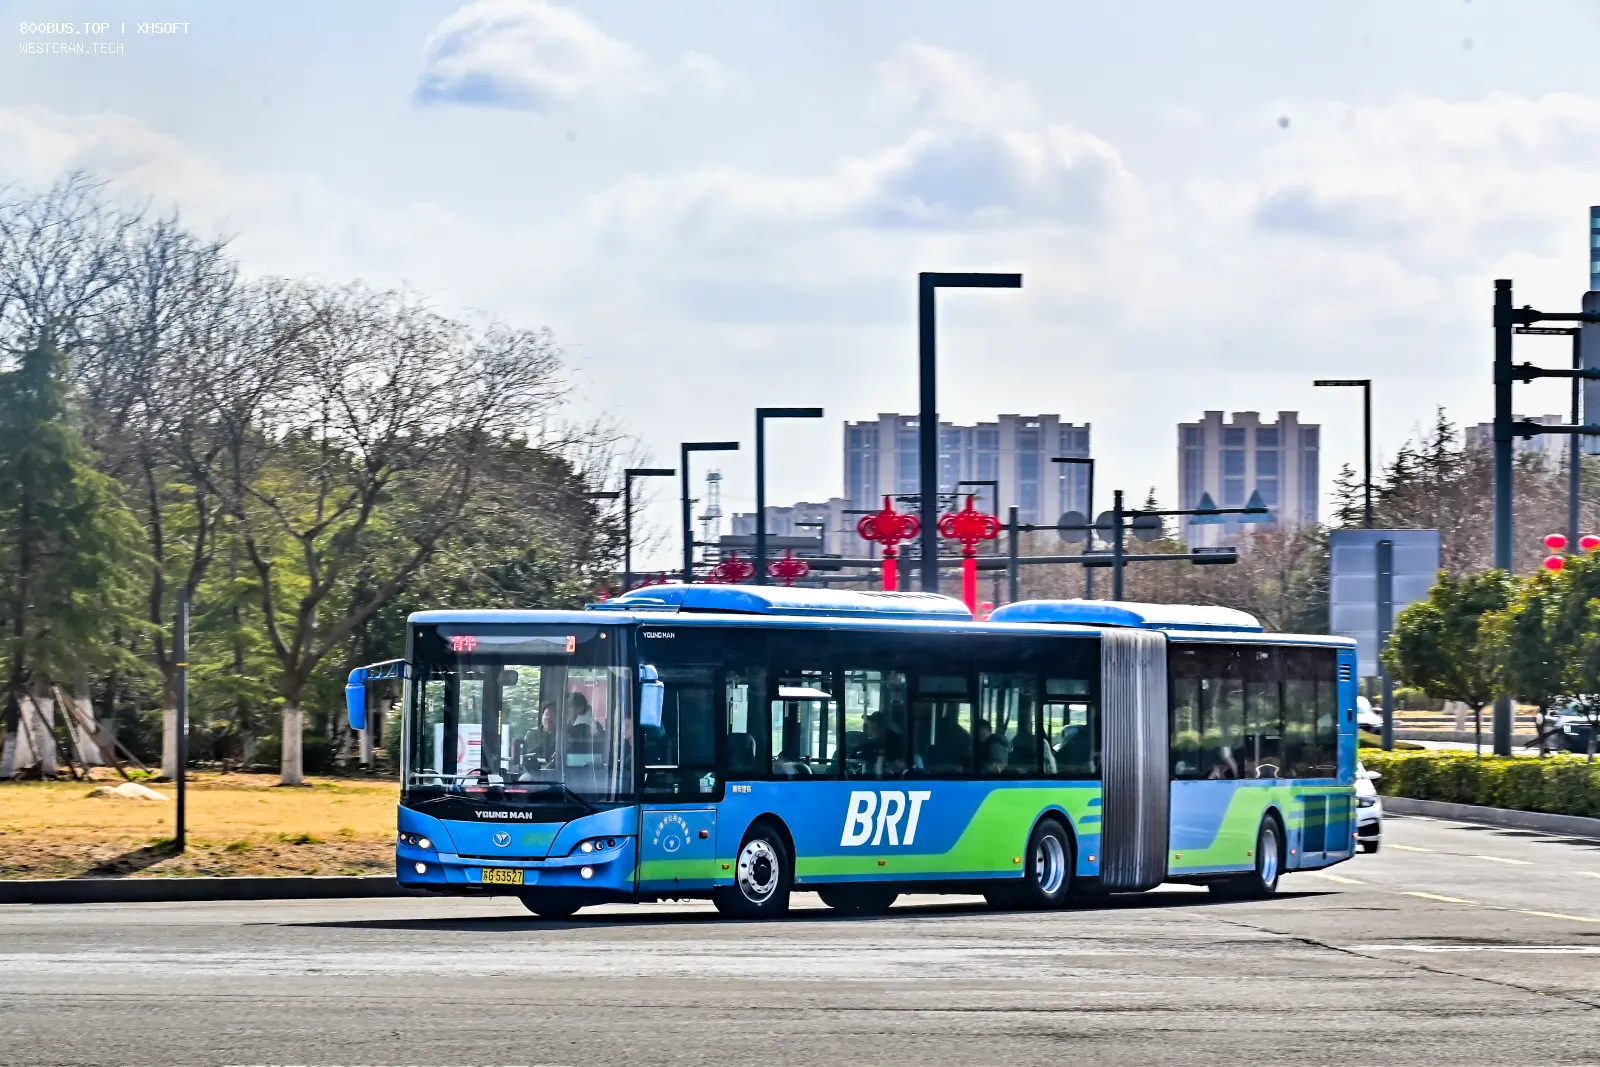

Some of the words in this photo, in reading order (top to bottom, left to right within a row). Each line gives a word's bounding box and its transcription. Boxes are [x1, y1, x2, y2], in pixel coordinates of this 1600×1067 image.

[643, 631, 662, 639] YOUNG
[474, 810, 509, 819] YOUNG
[509, 811, 533, 820] MAN
[840, 790, 931, 846] BRT
